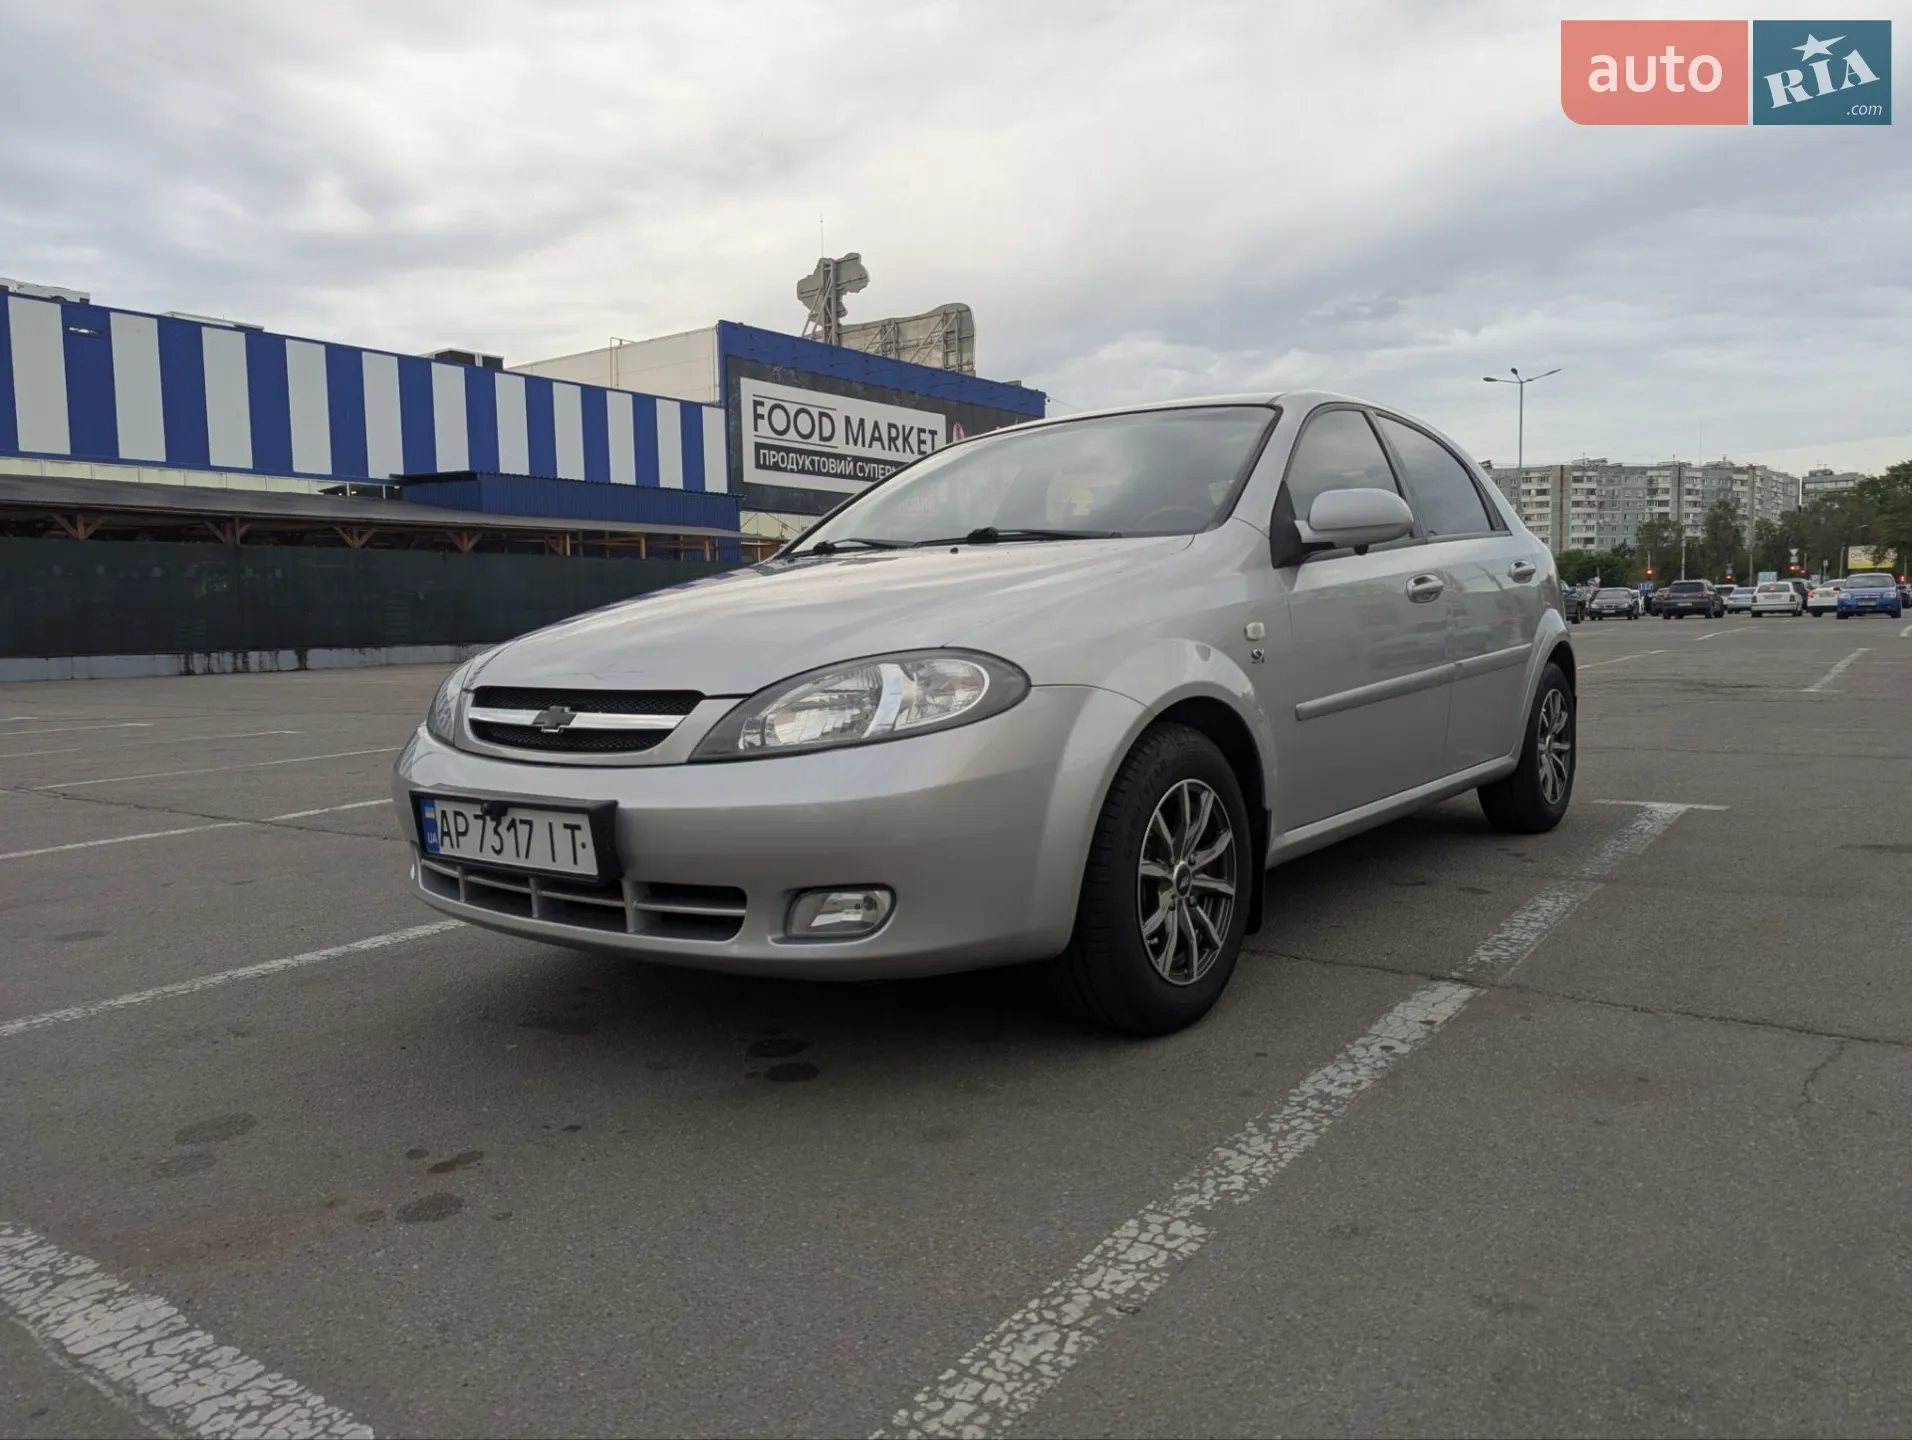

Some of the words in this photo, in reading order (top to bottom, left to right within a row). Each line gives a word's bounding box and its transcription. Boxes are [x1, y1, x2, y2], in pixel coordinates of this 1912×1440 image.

[752, 398, 837, 442] FOOD
[844, 414, 938, 456] MARKET
[759, 448, 855, 477] ПРОДУКТОВИЙ
[856, 461, 897, 479] СУПЕР
[427, 831, 439, 845] UA
[440, 809, 470, 850] AP
[473, 813, 534, 860] 7317
[548, 821, 582, 866] IT
